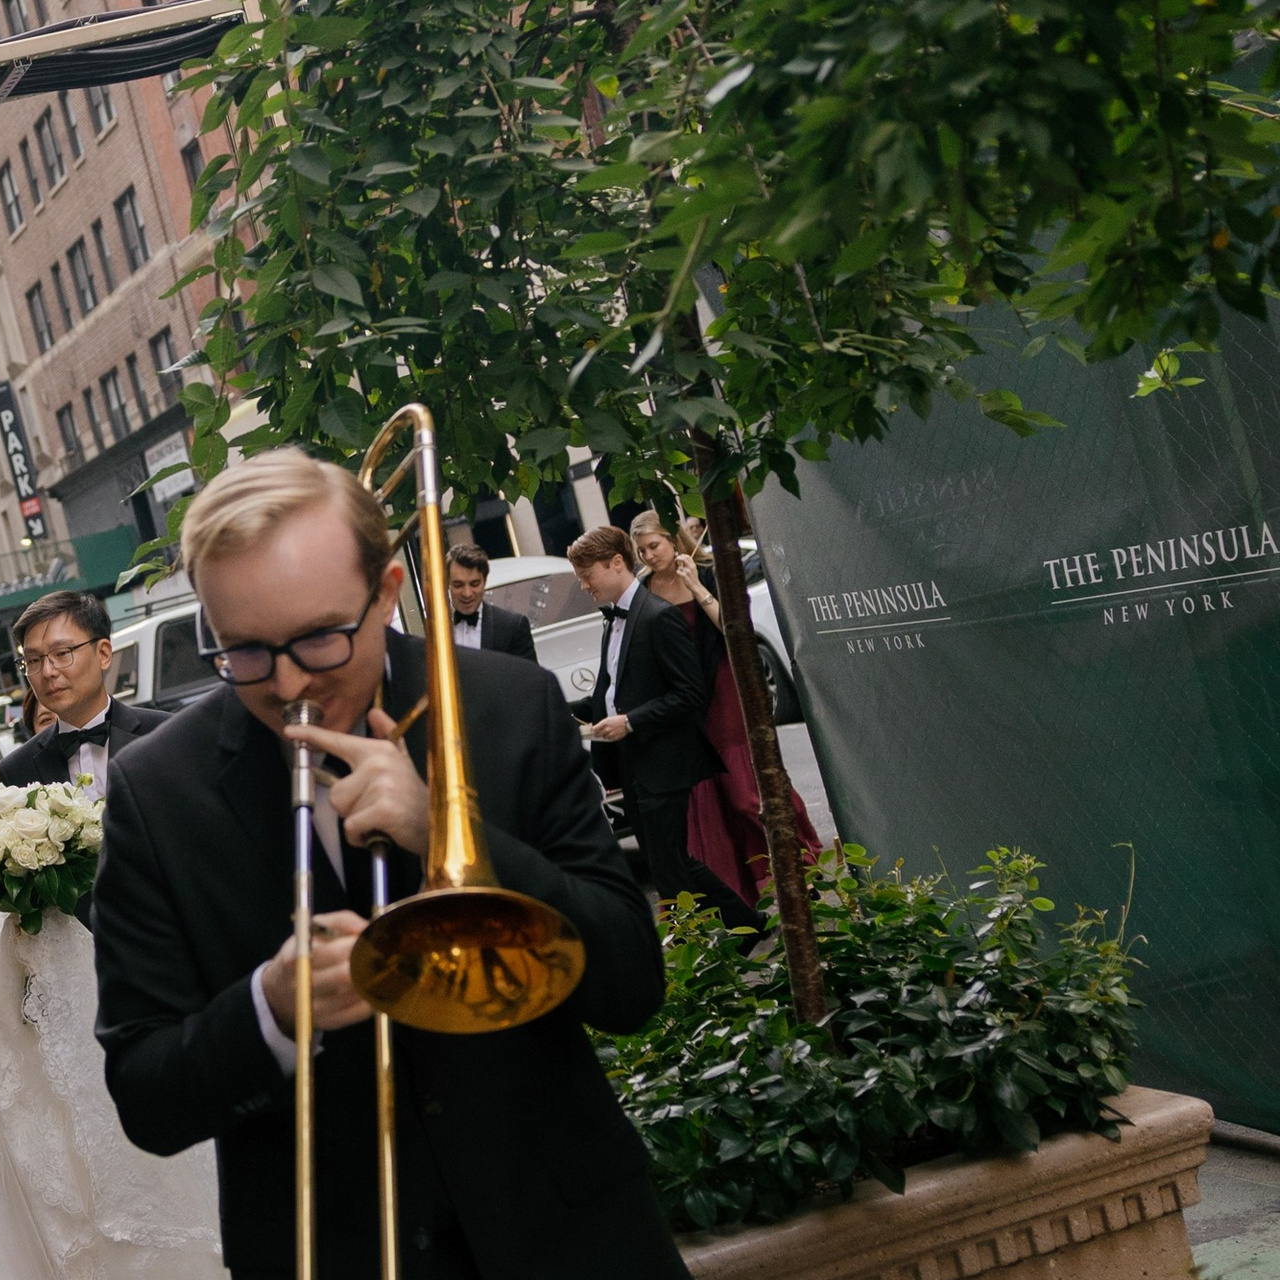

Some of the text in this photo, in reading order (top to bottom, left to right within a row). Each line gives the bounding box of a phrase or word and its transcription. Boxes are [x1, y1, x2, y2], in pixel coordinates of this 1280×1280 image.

[0, 410, 34, 498] PARK
[1043, 521, 1280, 590] THE PENINSULA
[807, 580, 947, 622] THE PENINSULA
[1103, 591, 1234, 625] NEW YORK
[846, 633, 926, 654] NEW YORK
